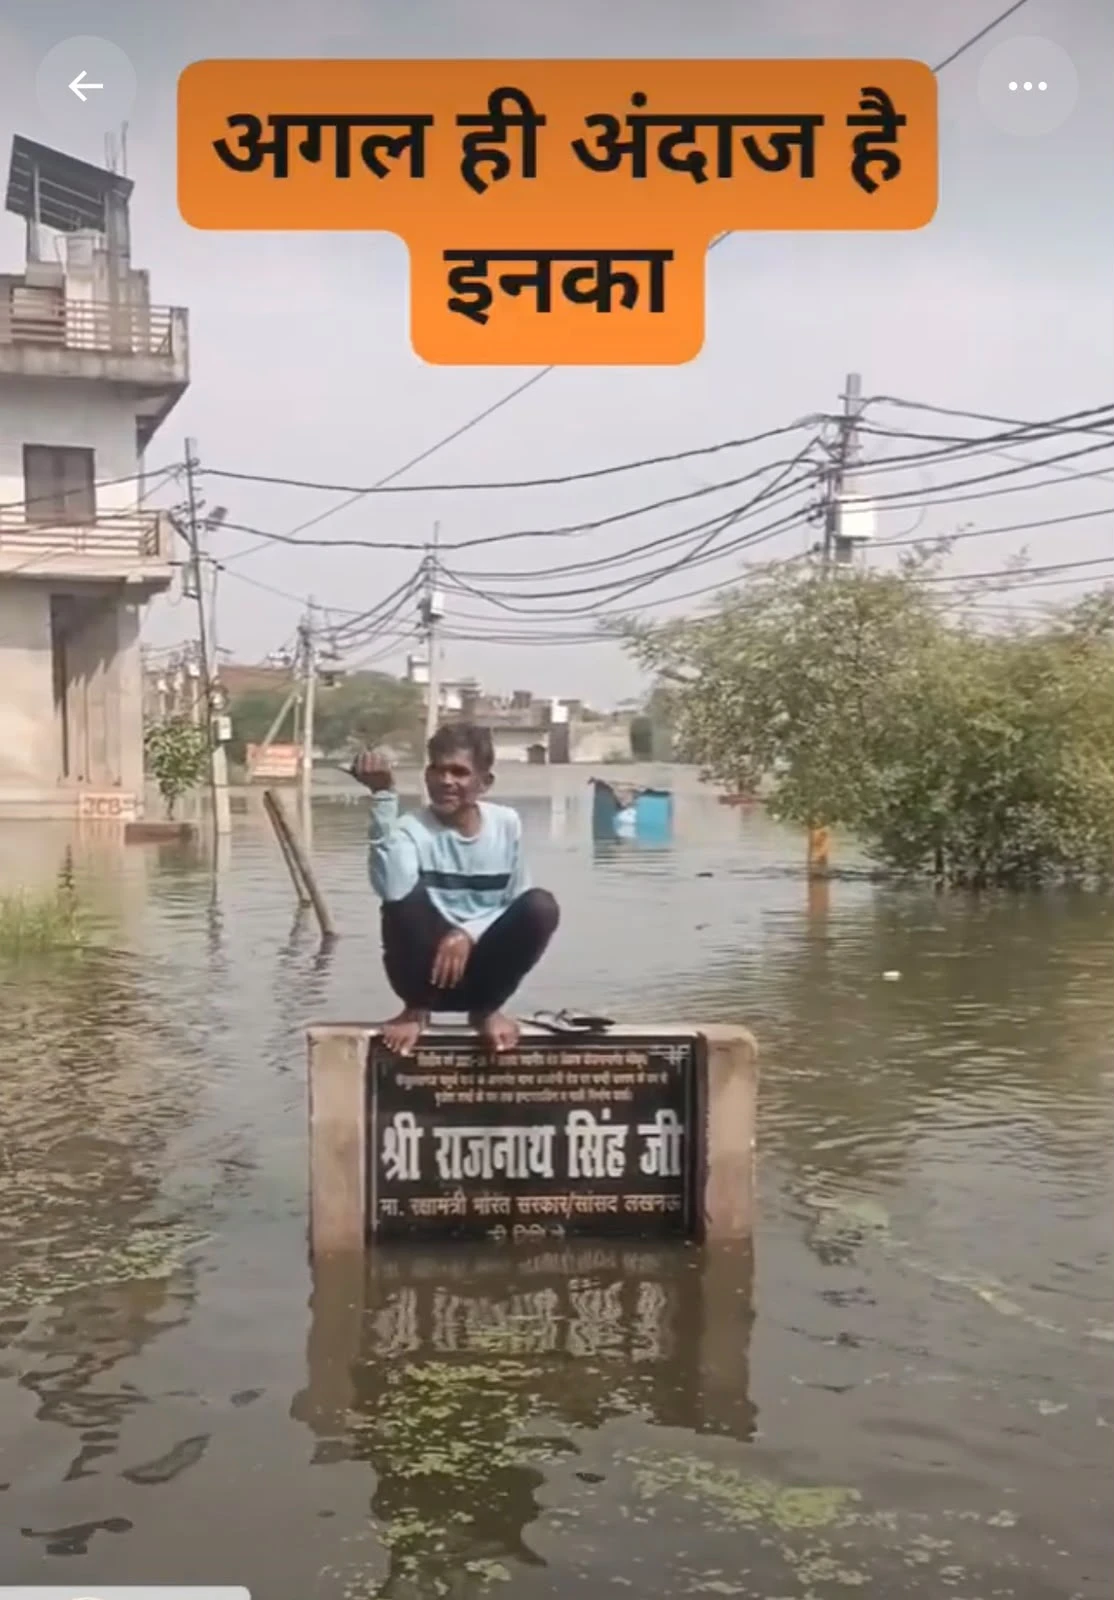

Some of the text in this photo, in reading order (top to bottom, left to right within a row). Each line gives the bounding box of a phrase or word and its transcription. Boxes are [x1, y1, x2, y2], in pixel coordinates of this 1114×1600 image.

[381, 1107, 684, 1180] श्री राजनाथ सिंह जी
